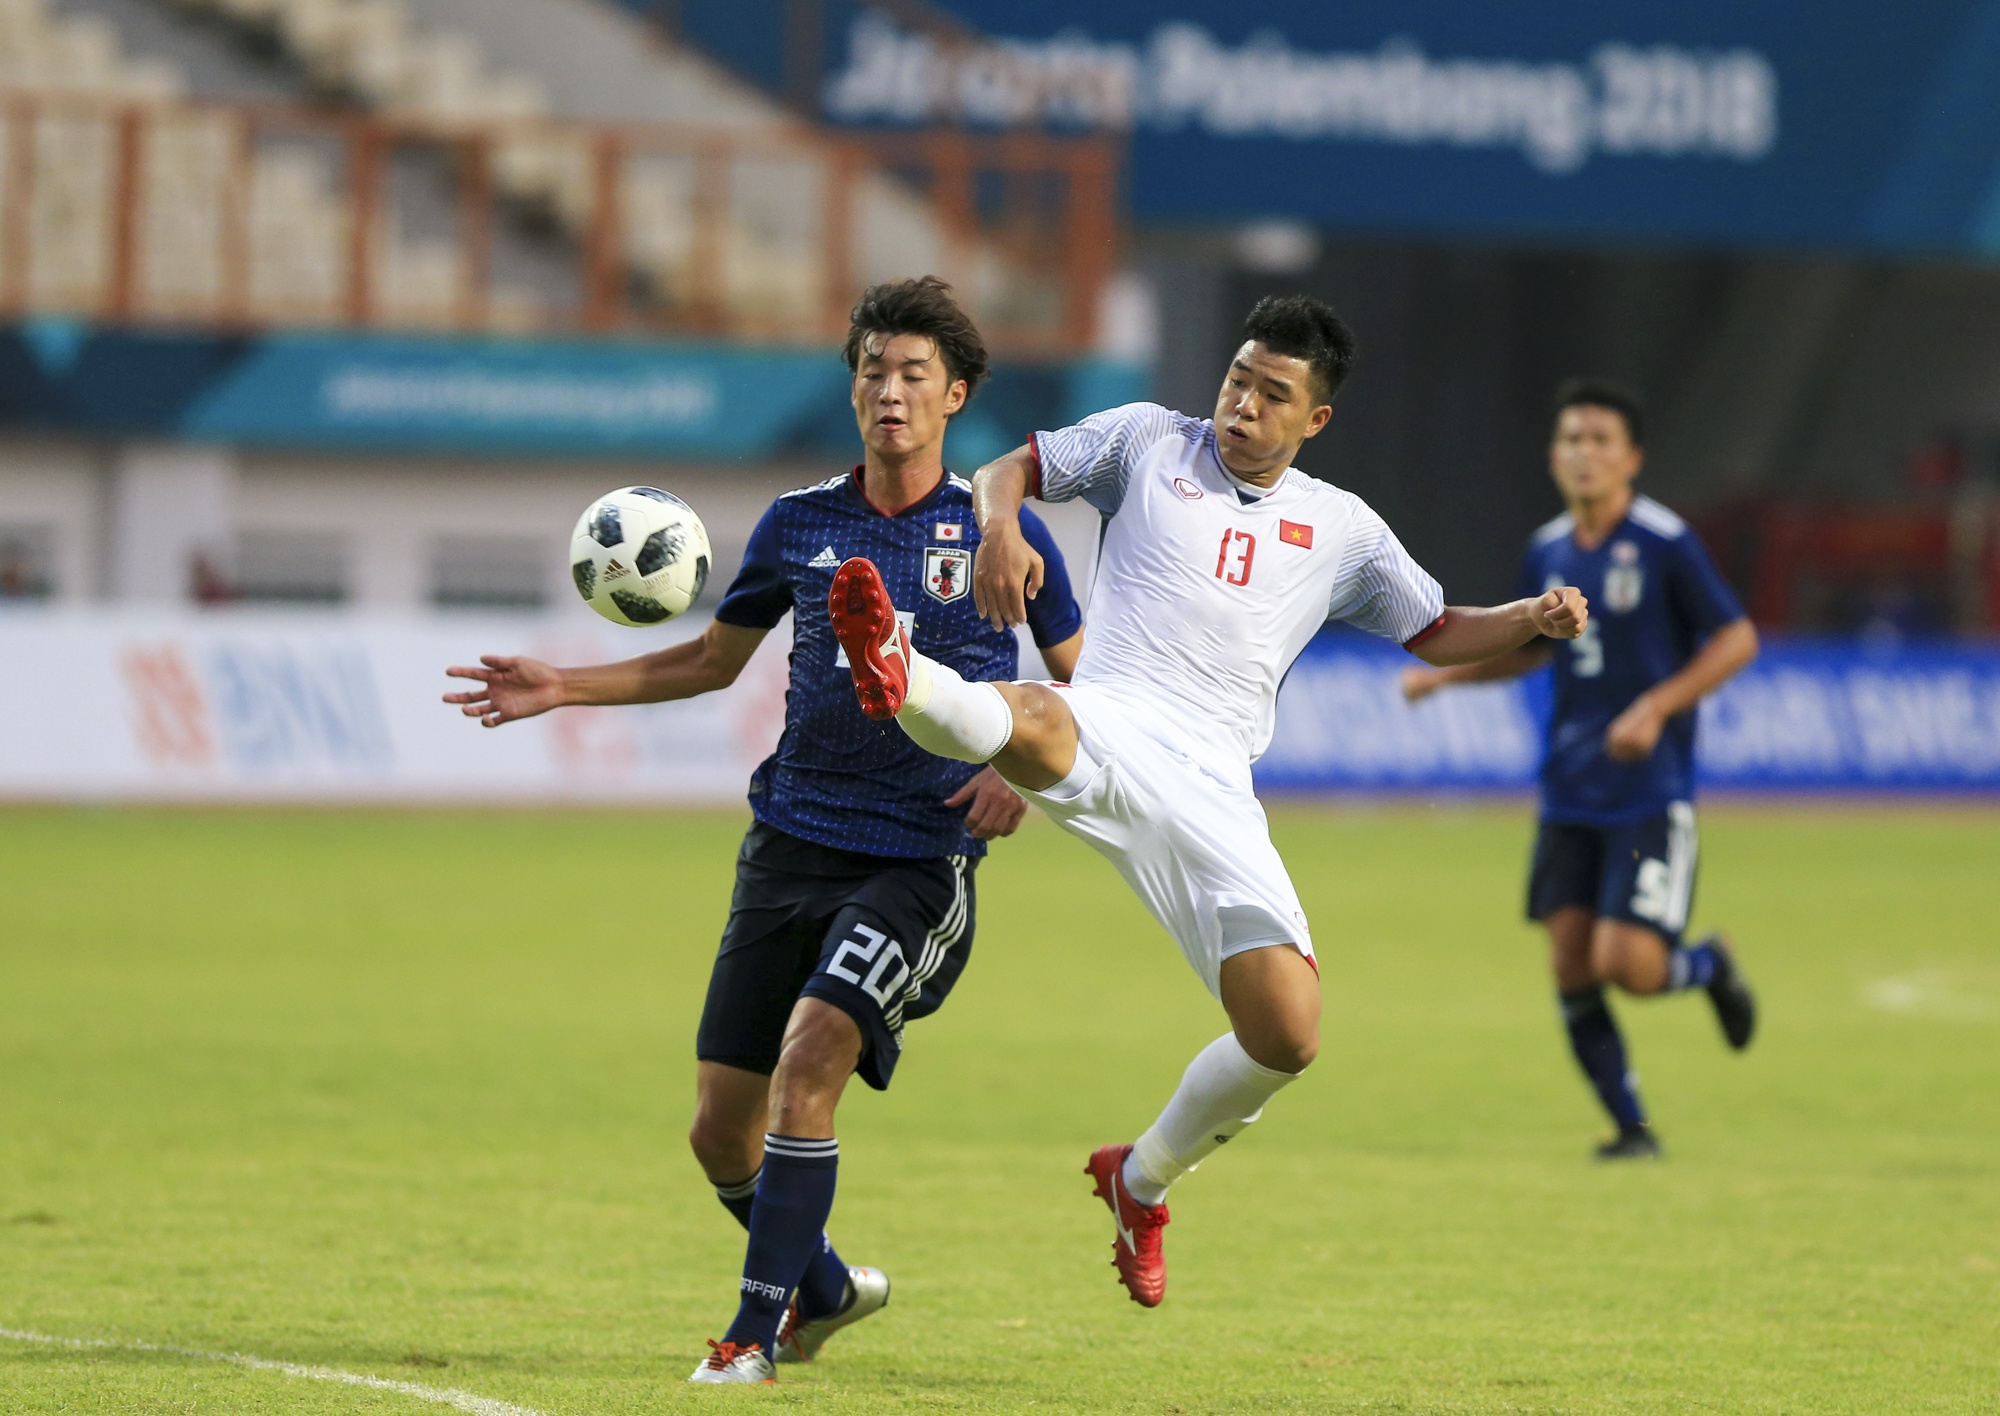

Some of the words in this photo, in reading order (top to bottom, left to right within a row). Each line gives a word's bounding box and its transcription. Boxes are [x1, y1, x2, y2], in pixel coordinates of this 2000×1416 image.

[1142, 25, 1592, 172] Palembang
[1596, 43, 1777, 157] 2018
[936, 584, 956, 594] JFA
[1215, 528, 1256, 587] 13
[827, 922, 910, 1009] 20
